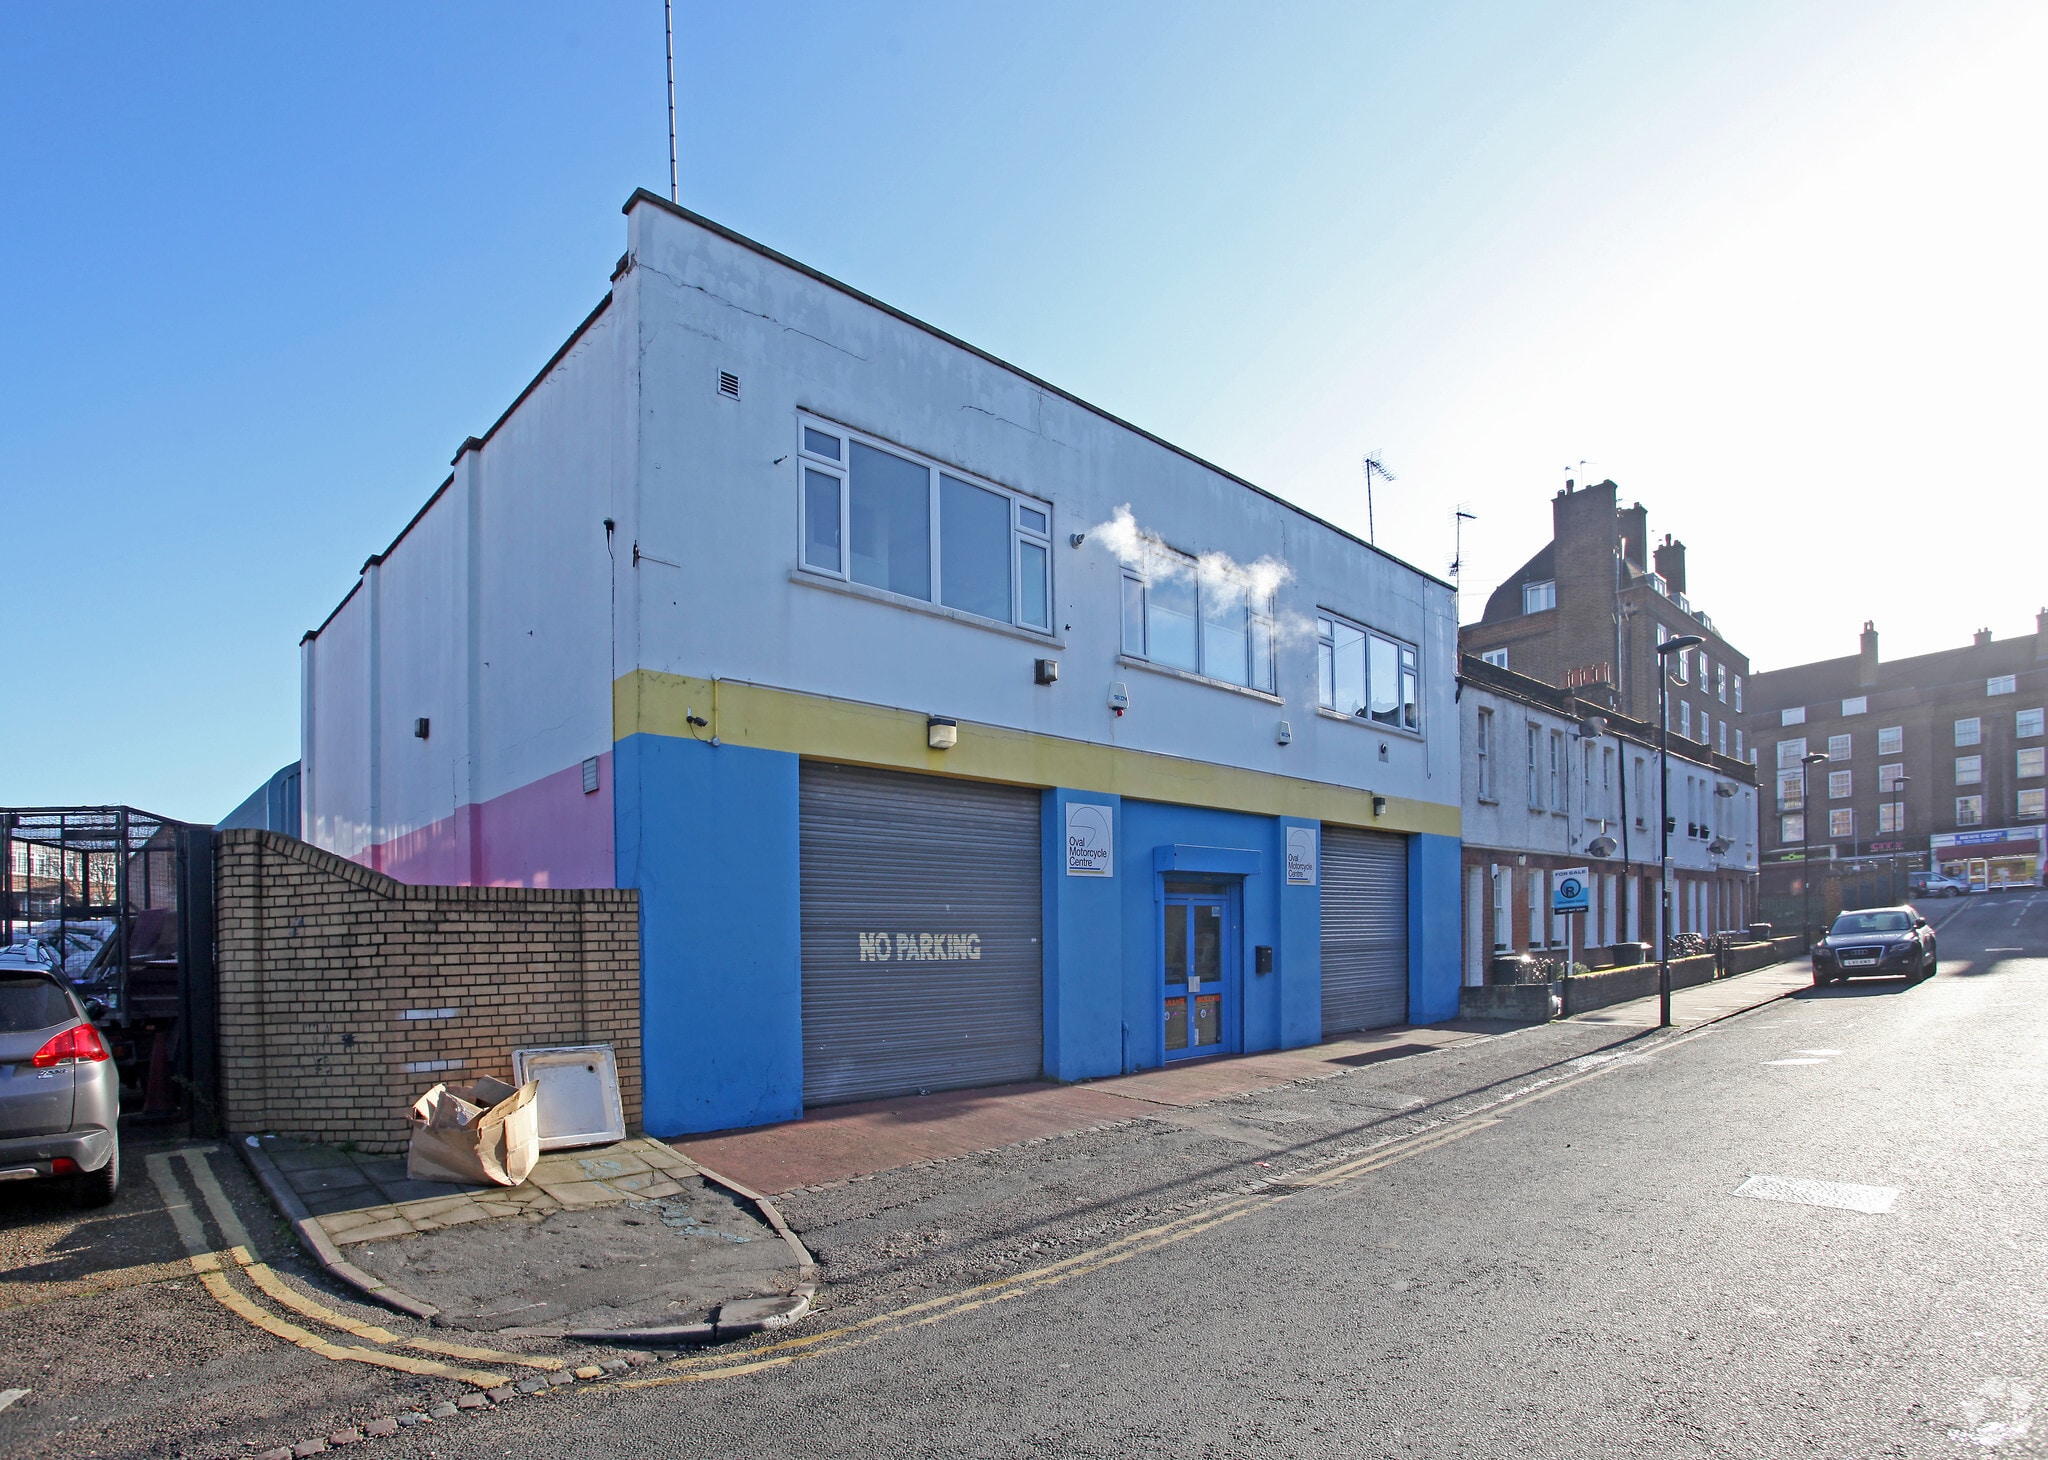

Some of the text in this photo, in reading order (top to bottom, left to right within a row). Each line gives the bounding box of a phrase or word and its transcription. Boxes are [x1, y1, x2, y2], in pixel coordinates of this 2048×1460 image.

[1069, 836, 1085, 847] Oval
[1069, 846, 1107, 860] Motorcycle
[1288, 853, 1299, 862] Oval
[1069, 856, 1093, 867] Centre
[1288, 862, 1313, 871] Motorcycle
[1288, 869, 1303, 877] Centre
[859, 932, 981, 961] NO PARKING
